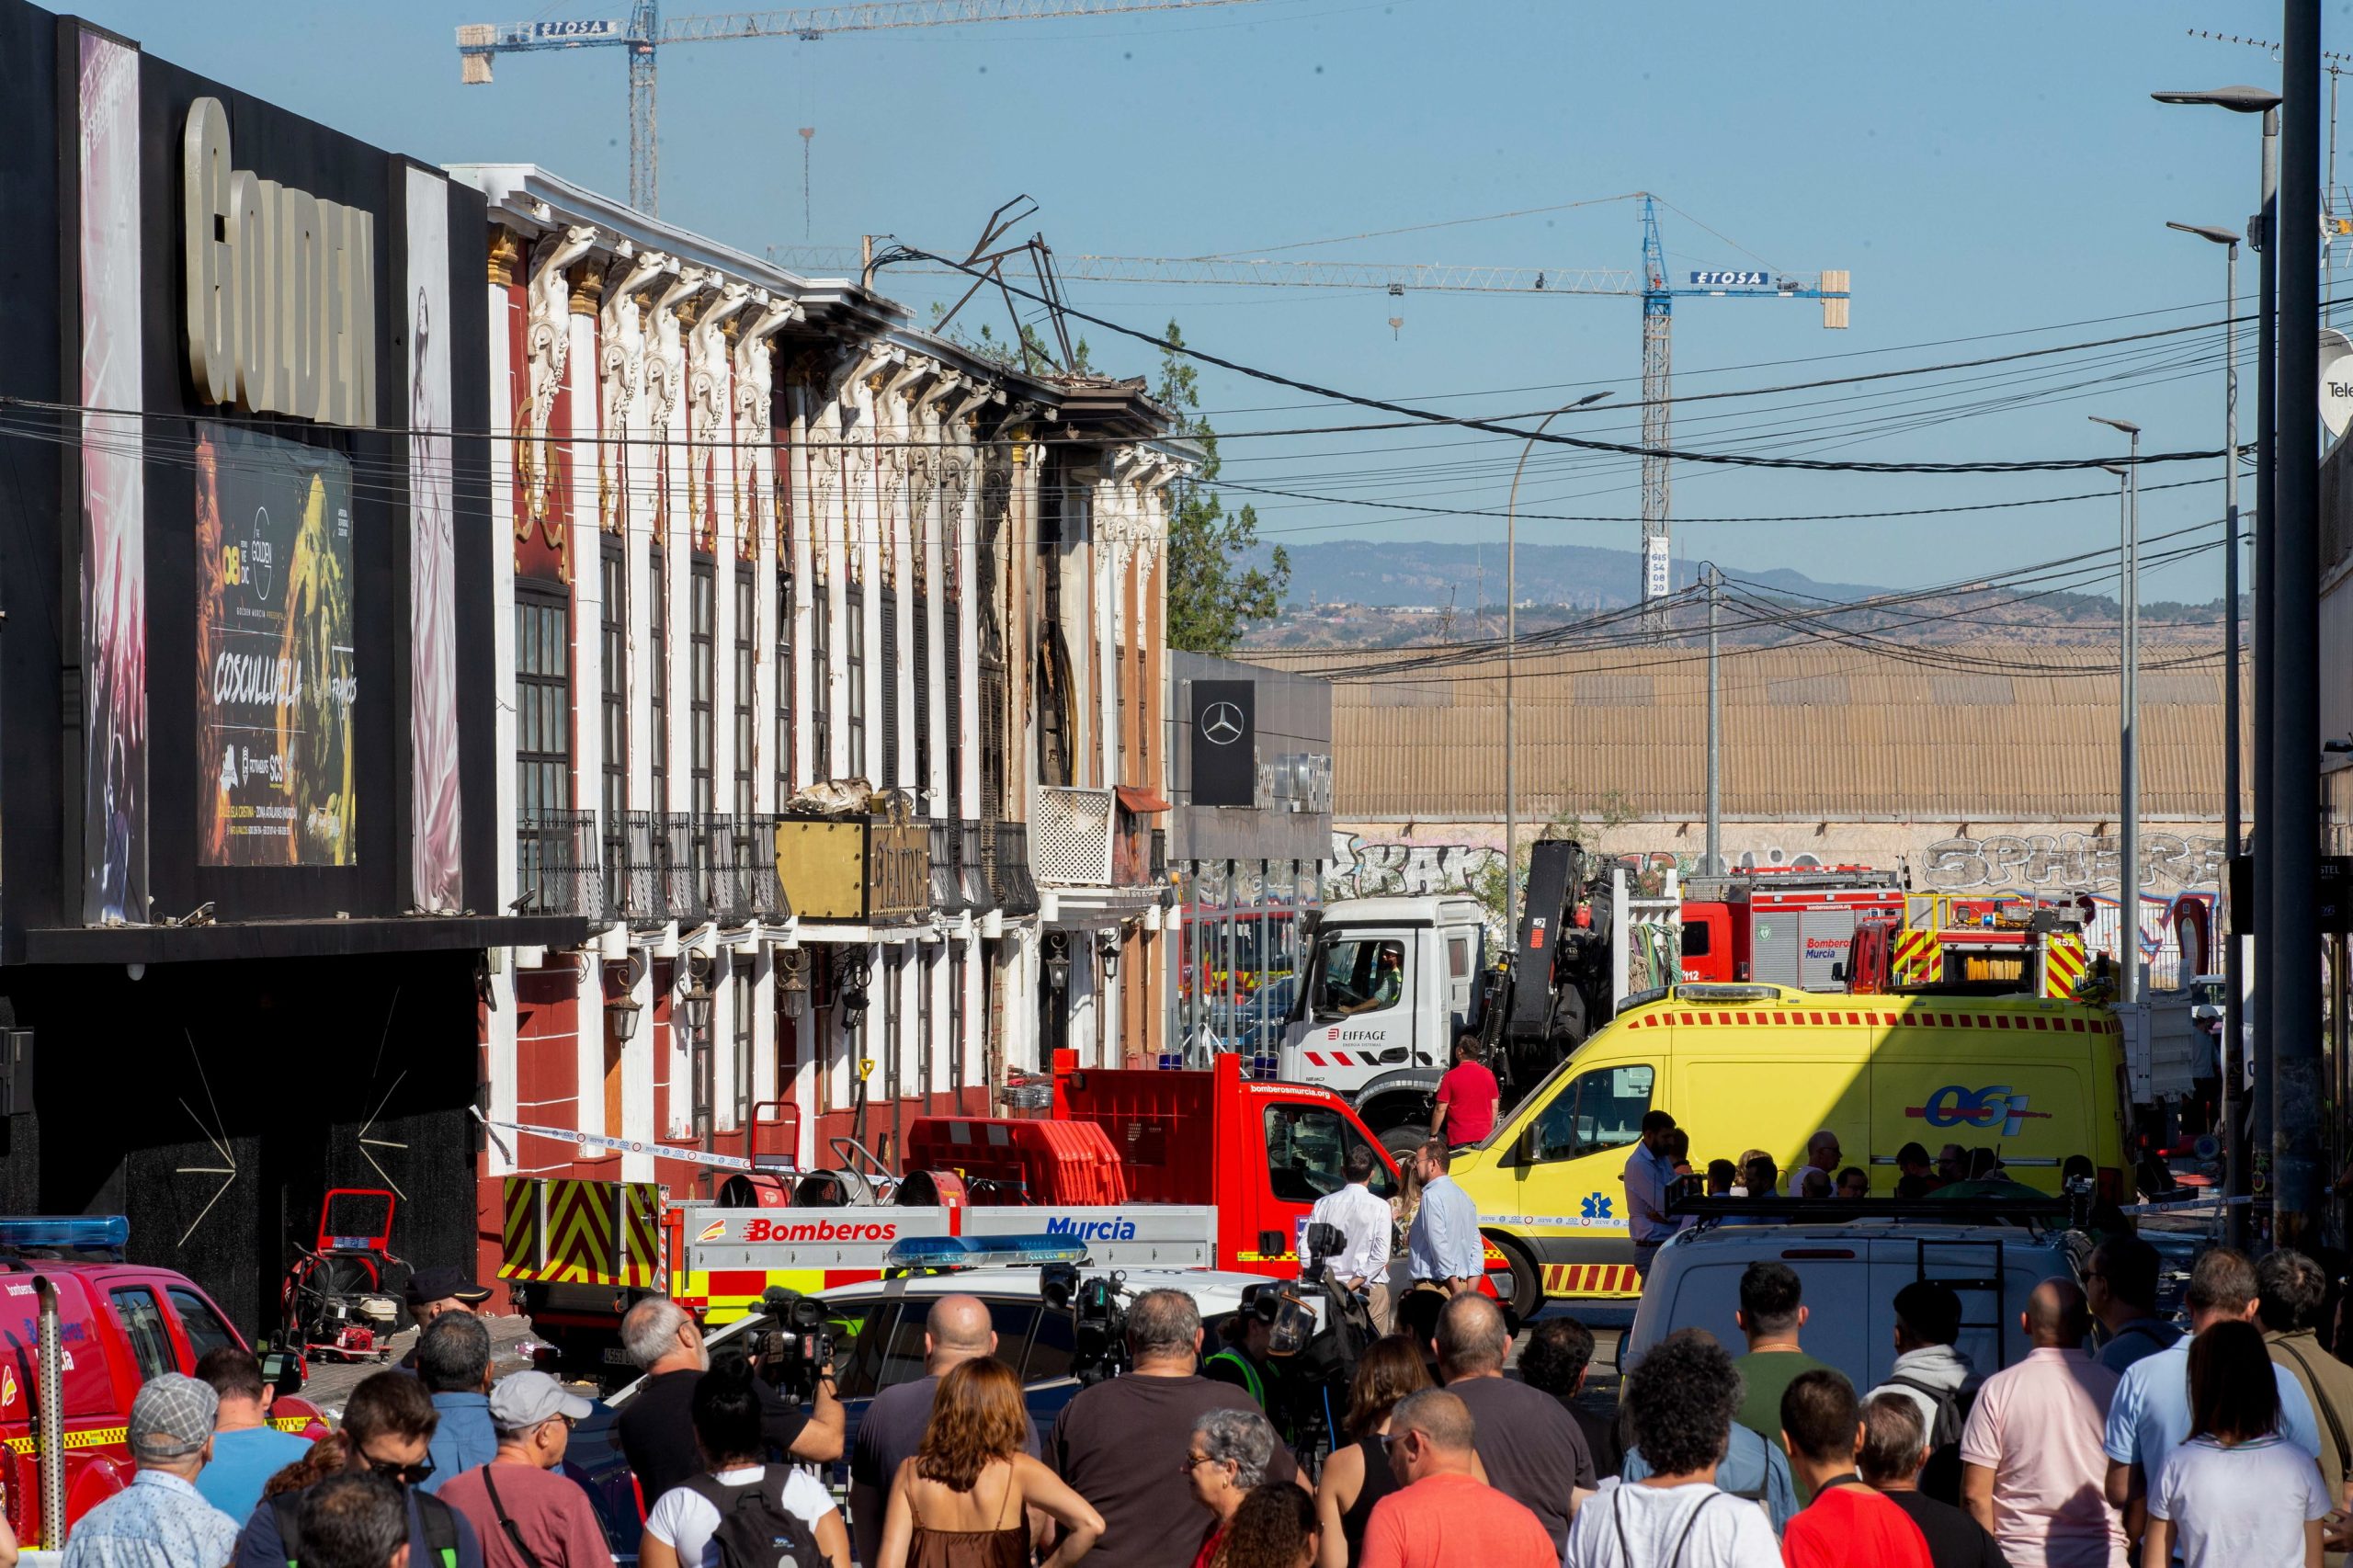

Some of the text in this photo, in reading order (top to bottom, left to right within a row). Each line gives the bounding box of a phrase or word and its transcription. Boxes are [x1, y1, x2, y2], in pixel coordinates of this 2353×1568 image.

[541, 22, 601, 36] ETOSA
[185, 97, 377, 427] GOLDEN
[1698, 272, 1760, 284] ETOSA
[252, 540, 272, 564] GOLDEN
[222, 545, 241, 585] 08
[213, 652, 302, 708] COSCULLUELA
[2053, 937, 2075, 947] R52
[1805, 949, 1836, 959] Murcia
[1342, 1030, 1386, 1040] EIFFAGE
[1250, 1085, 1331, 1099] bomberosmurcia.org
[1926, 1085, 2029, 1136] 061
[744, 1219, 897, 1241] Bomberos
[1046, 1216, 1136, 1240] Murcia
